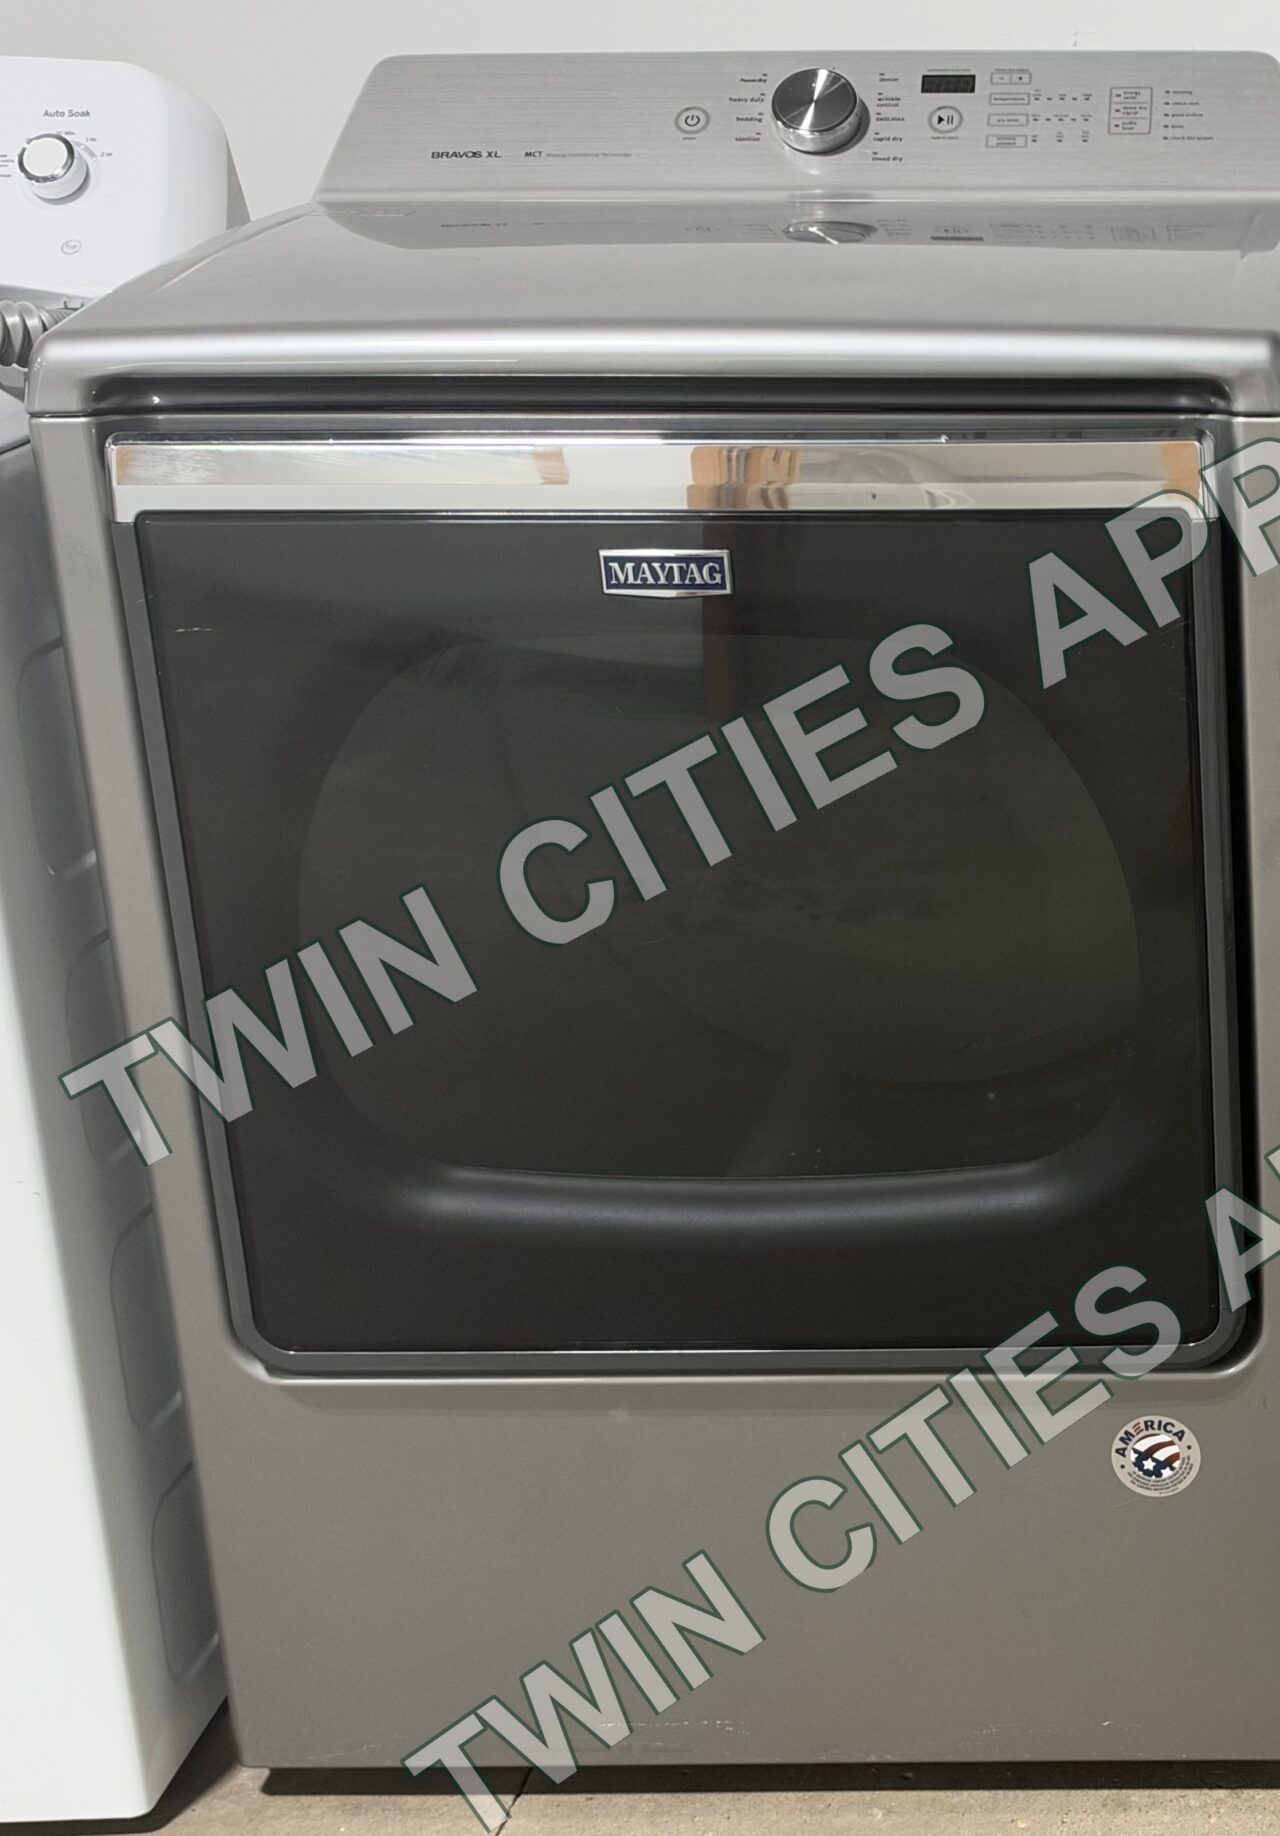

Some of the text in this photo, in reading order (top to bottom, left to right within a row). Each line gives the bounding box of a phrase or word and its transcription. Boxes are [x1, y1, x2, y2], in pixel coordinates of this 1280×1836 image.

[43, 109, 91, 117] Auto Soak
[431, 150, 482, 159] BRAVOS
[485, 150, 502, 159] XL
[524, 150, 543, 158] MCT
[608, 562, 721, 585] MAYTAG
[1115, 1419, 1186, 1458] AMERICA
